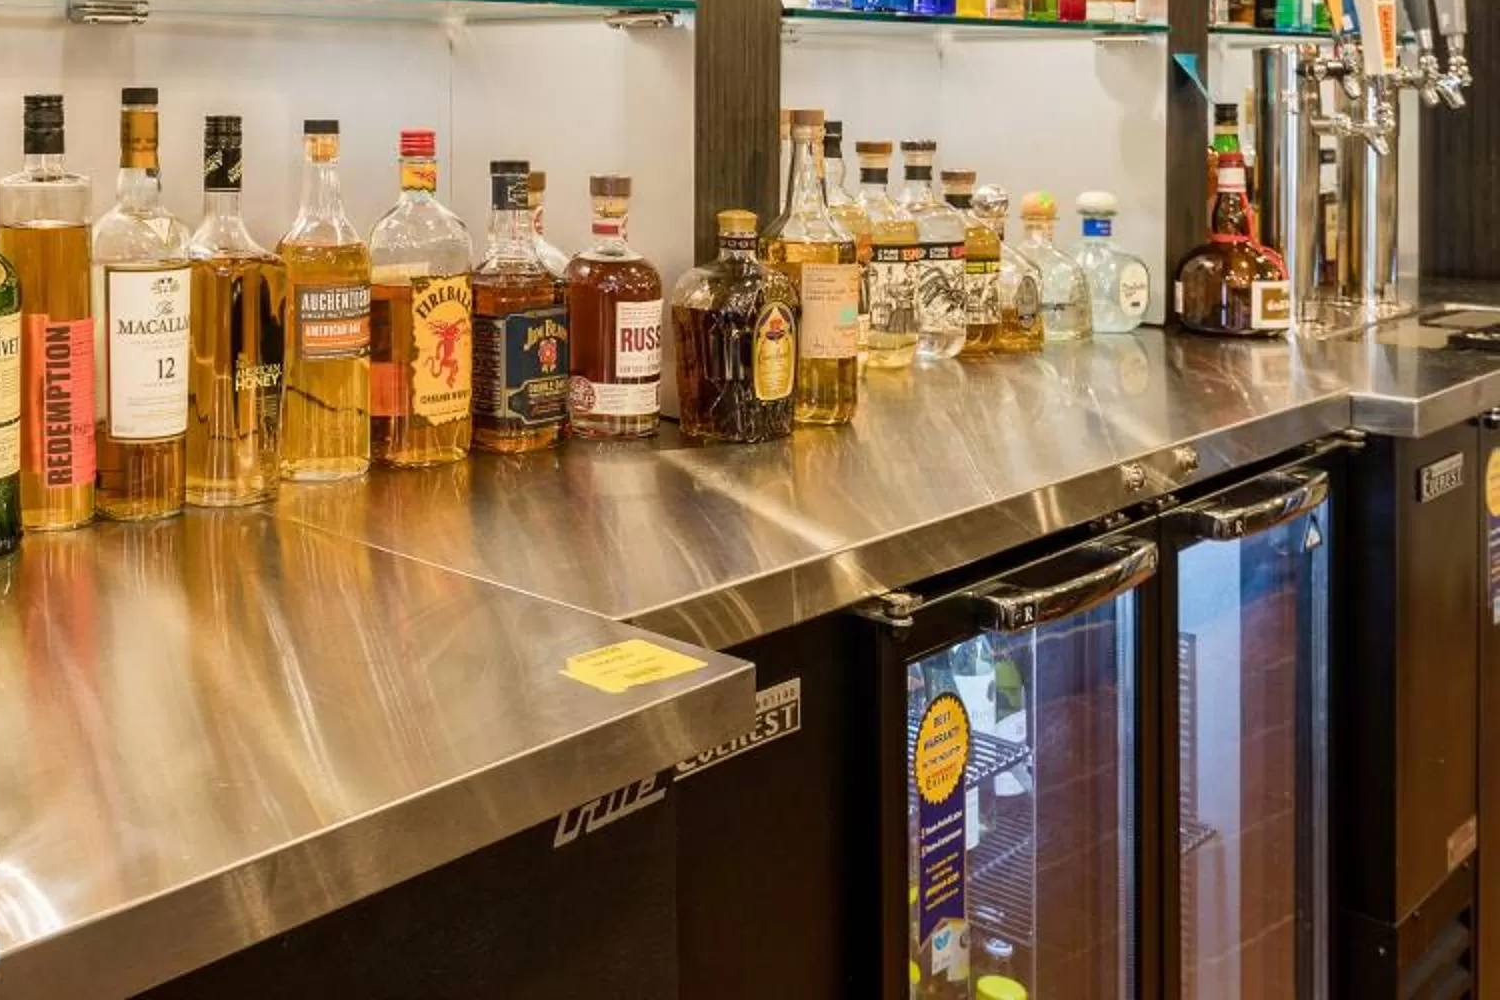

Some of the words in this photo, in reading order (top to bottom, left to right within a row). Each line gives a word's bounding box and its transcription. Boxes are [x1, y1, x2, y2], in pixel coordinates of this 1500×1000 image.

[116, 317, 190, 335] MACALL
[157, 356, 176, 380] 12
[234, 373, 278, 392] HONEY
[45, 327, 73, 486] REDEMPTION
